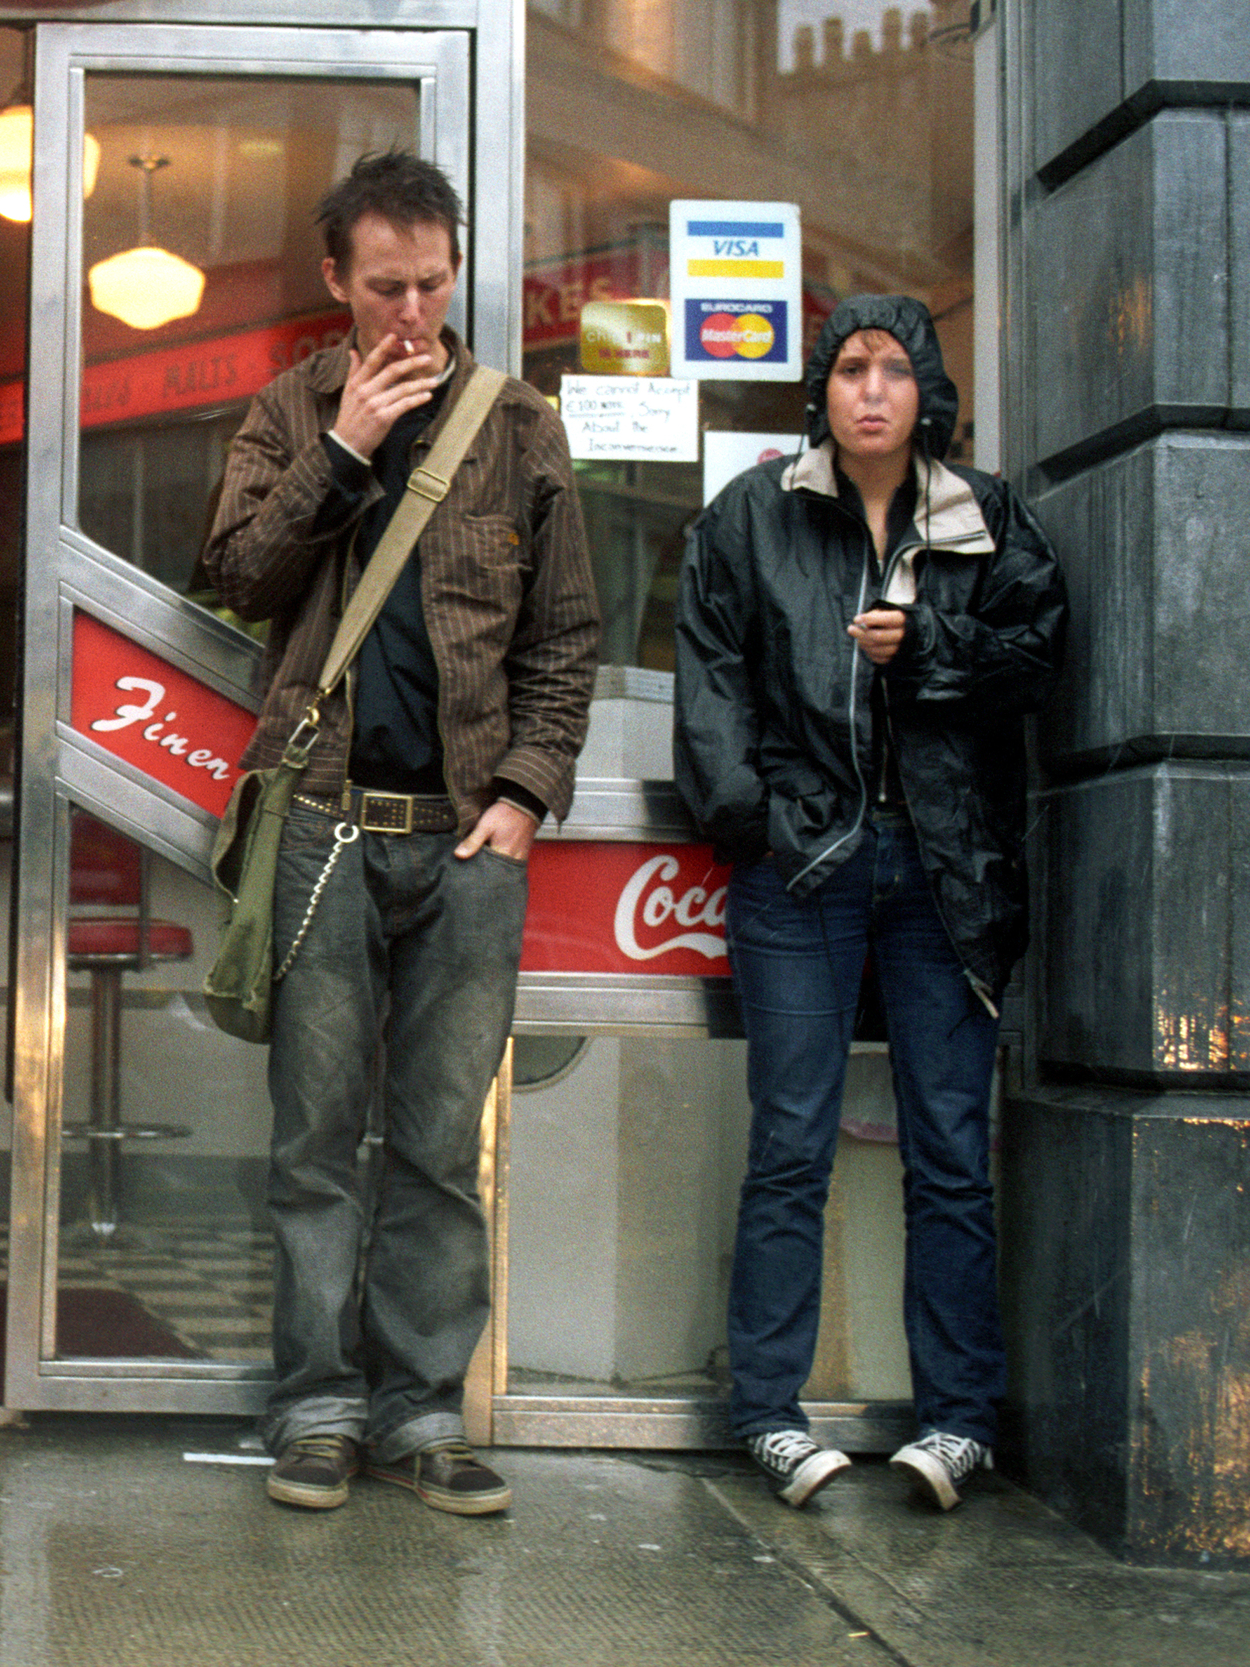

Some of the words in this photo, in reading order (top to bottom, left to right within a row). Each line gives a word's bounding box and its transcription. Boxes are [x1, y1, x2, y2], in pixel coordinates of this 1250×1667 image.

[713, 240, 760, 257] VISA
[700, 302, 773, 314] EUROCARD
[700, 329, 773, 344] MasterCard
